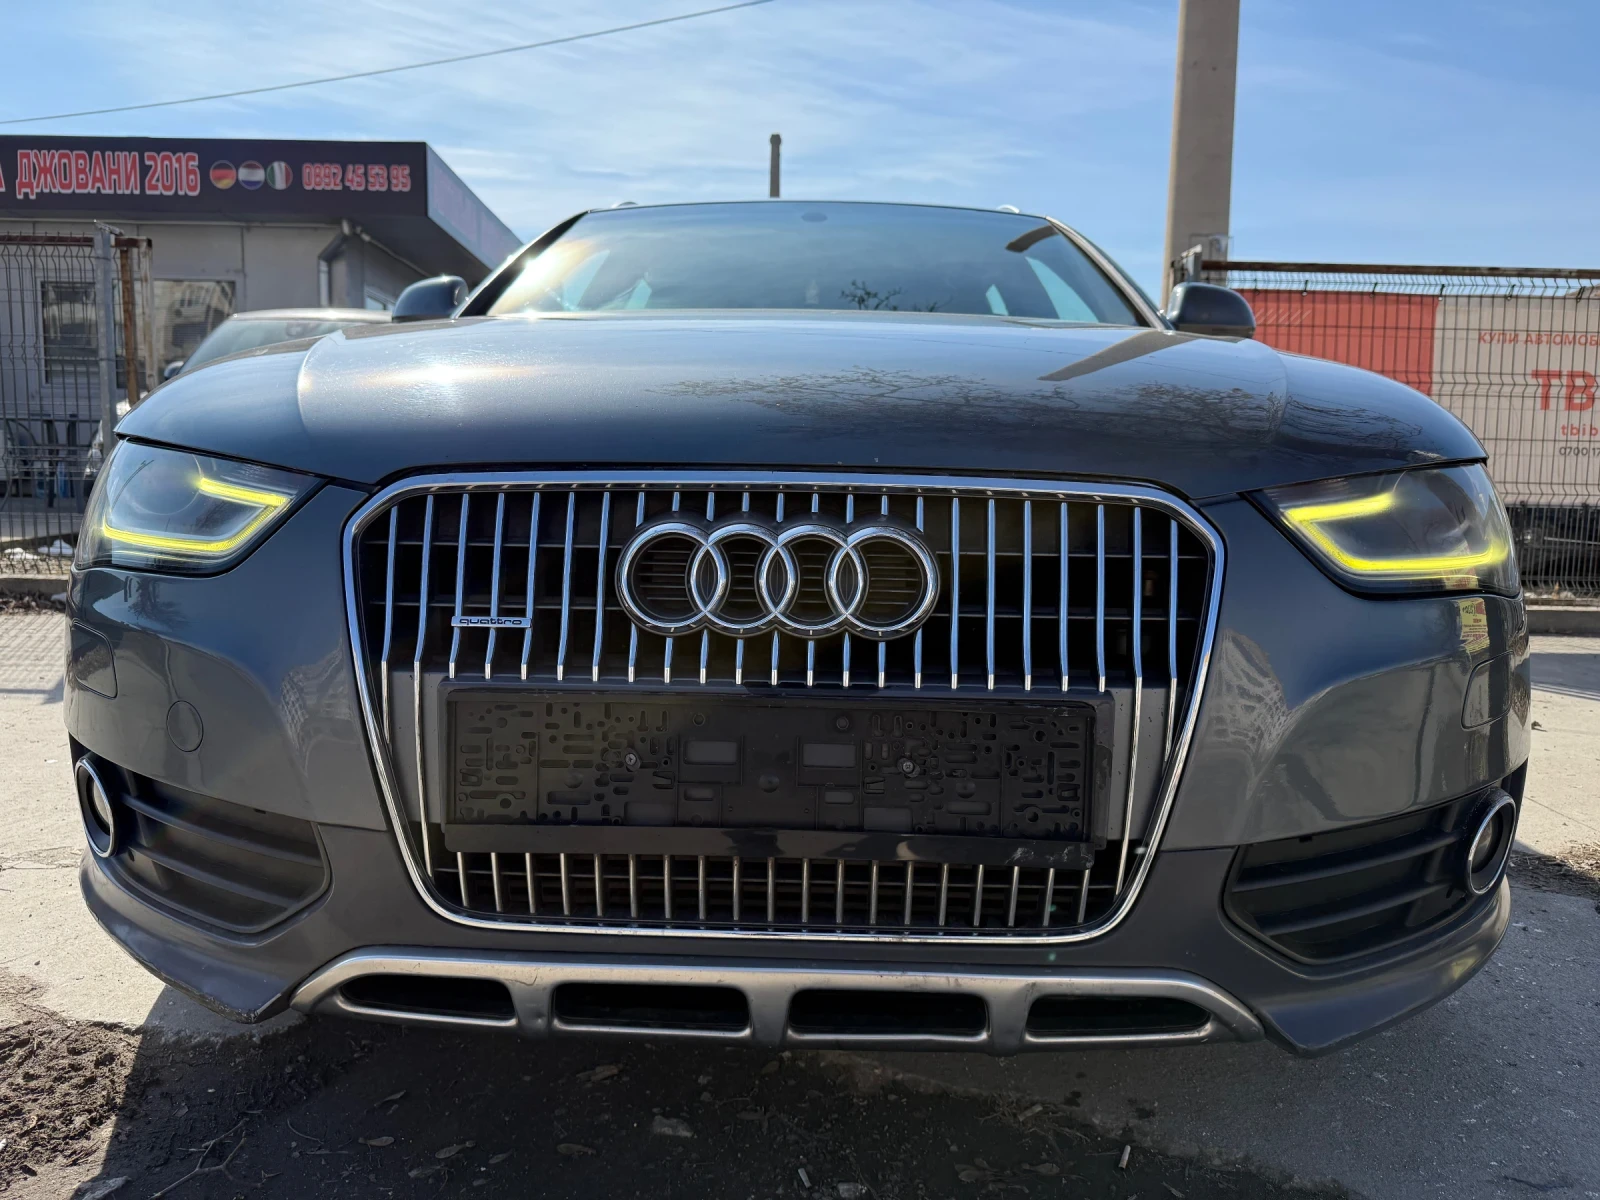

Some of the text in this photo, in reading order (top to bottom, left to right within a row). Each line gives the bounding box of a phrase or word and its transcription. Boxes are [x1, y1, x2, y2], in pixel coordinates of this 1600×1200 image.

[16, 150, 140, 199] ДЖОВАНИ
[145, 152, 200, 196] 2016
[302, 163, 411, 192] 0892 45 53 95
[1479, 332, 1600, 347] КУПИ АВТОМОБ
[1559, 446, 1589, 456] 0700
